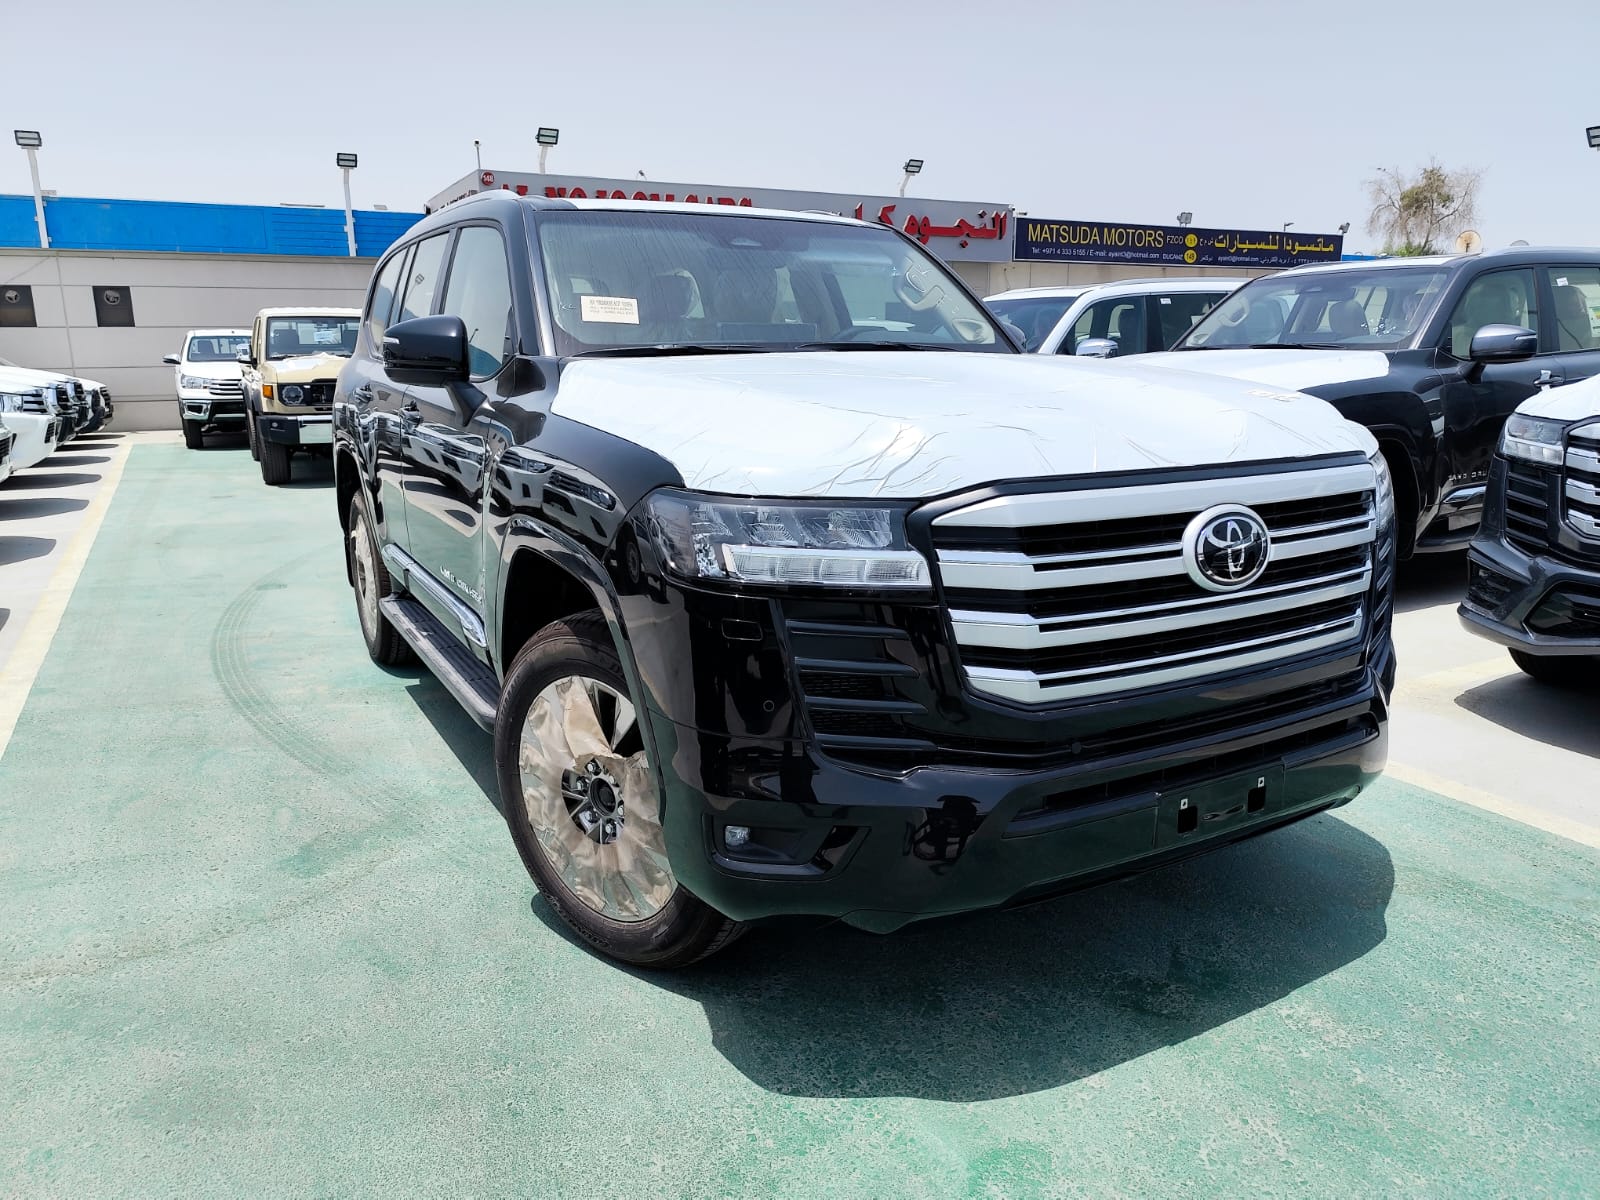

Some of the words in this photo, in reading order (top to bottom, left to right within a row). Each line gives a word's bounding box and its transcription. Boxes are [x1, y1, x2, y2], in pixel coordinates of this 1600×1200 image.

[1028, 223, 1101, 245] MATSUDA
[1103, 227, 1164, 248] MOTORS
[1166, 235, 1184, 245] FZCO
[1214, 233, 1279, 254] للسيارات
[1283, 235, 1334, 255] ماتسودا
[1042, 247, 1055, 255] +971
